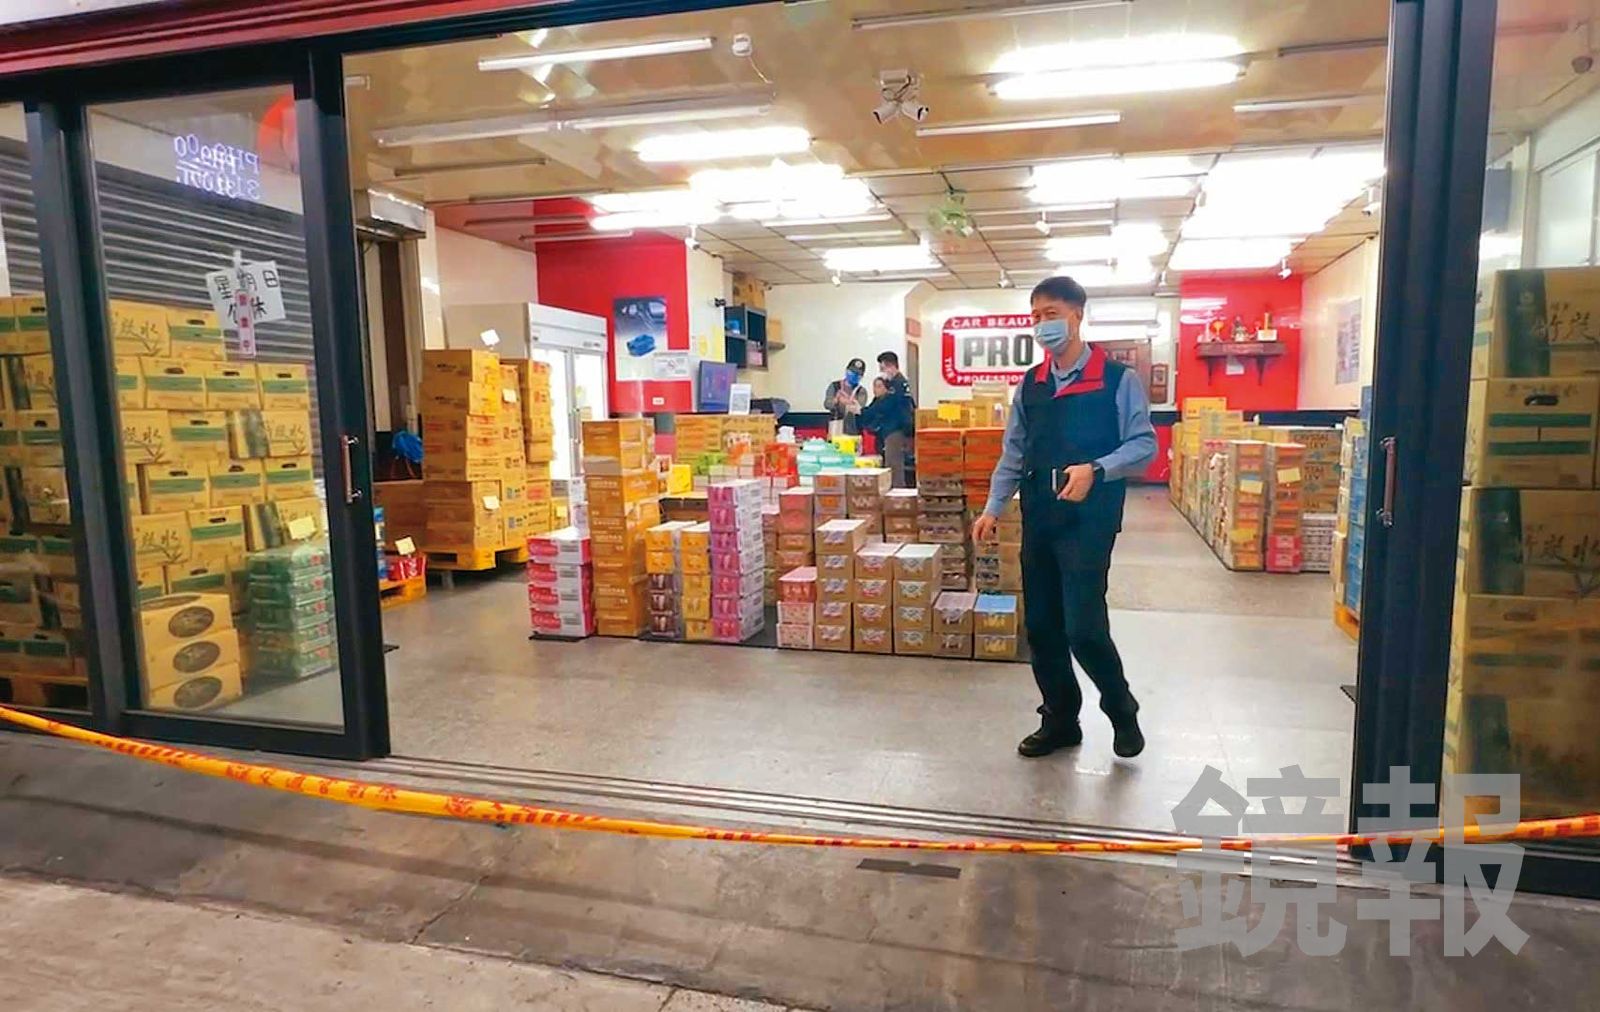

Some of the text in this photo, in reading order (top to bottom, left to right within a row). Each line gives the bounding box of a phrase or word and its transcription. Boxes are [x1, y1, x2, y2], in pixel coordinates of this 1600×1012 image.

[951, 316, 1034, 328] CAR BEAUT
[963, 334, 1033, 367] PRO
[956, 374, 1025, 384] PROFESSION
